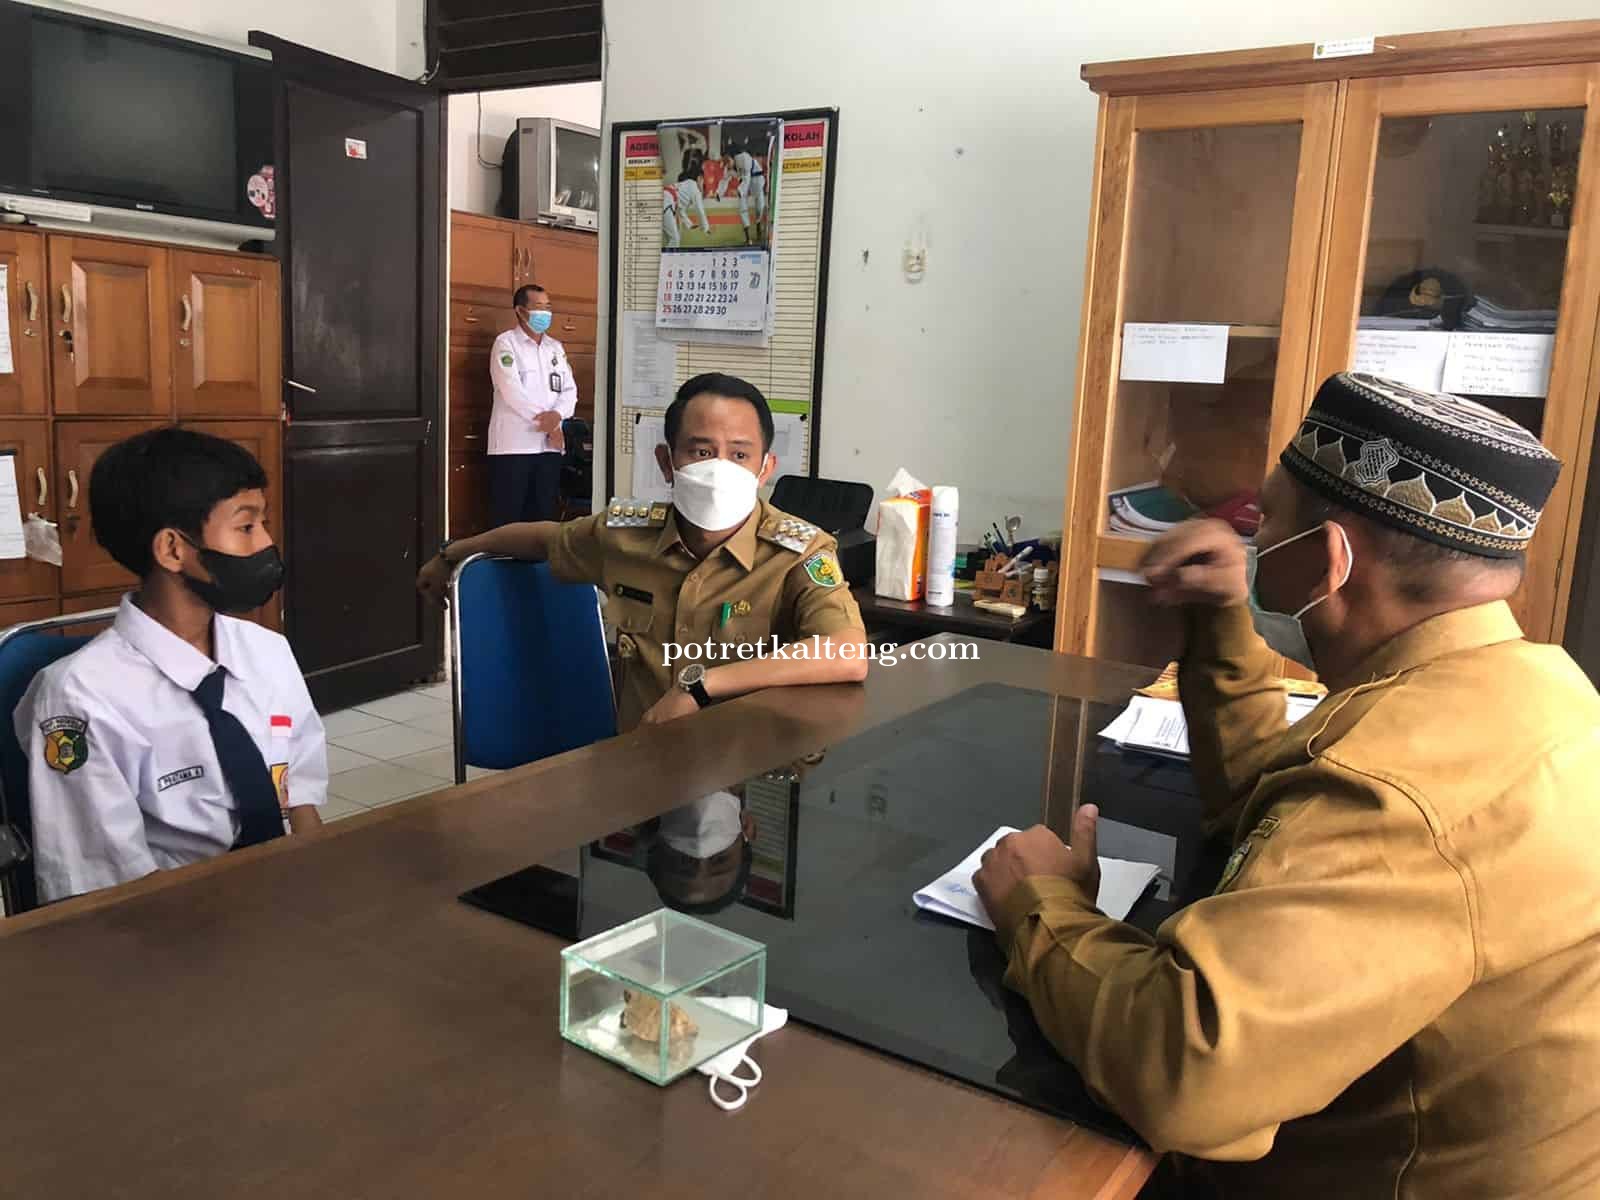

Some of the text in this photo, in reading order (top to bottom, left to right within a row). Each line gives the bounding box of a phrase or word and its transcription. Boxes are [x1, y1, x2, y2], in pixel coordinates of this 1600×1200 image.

[730, 270, 739, 279] 10
[666, 281, 738, 290] 11 12 13 14 15 16 17
[664, 293, 738, 303] 18 19 20 21 22 23 24
[663, 305, 727, 315] 25 26 27 28 29 30
